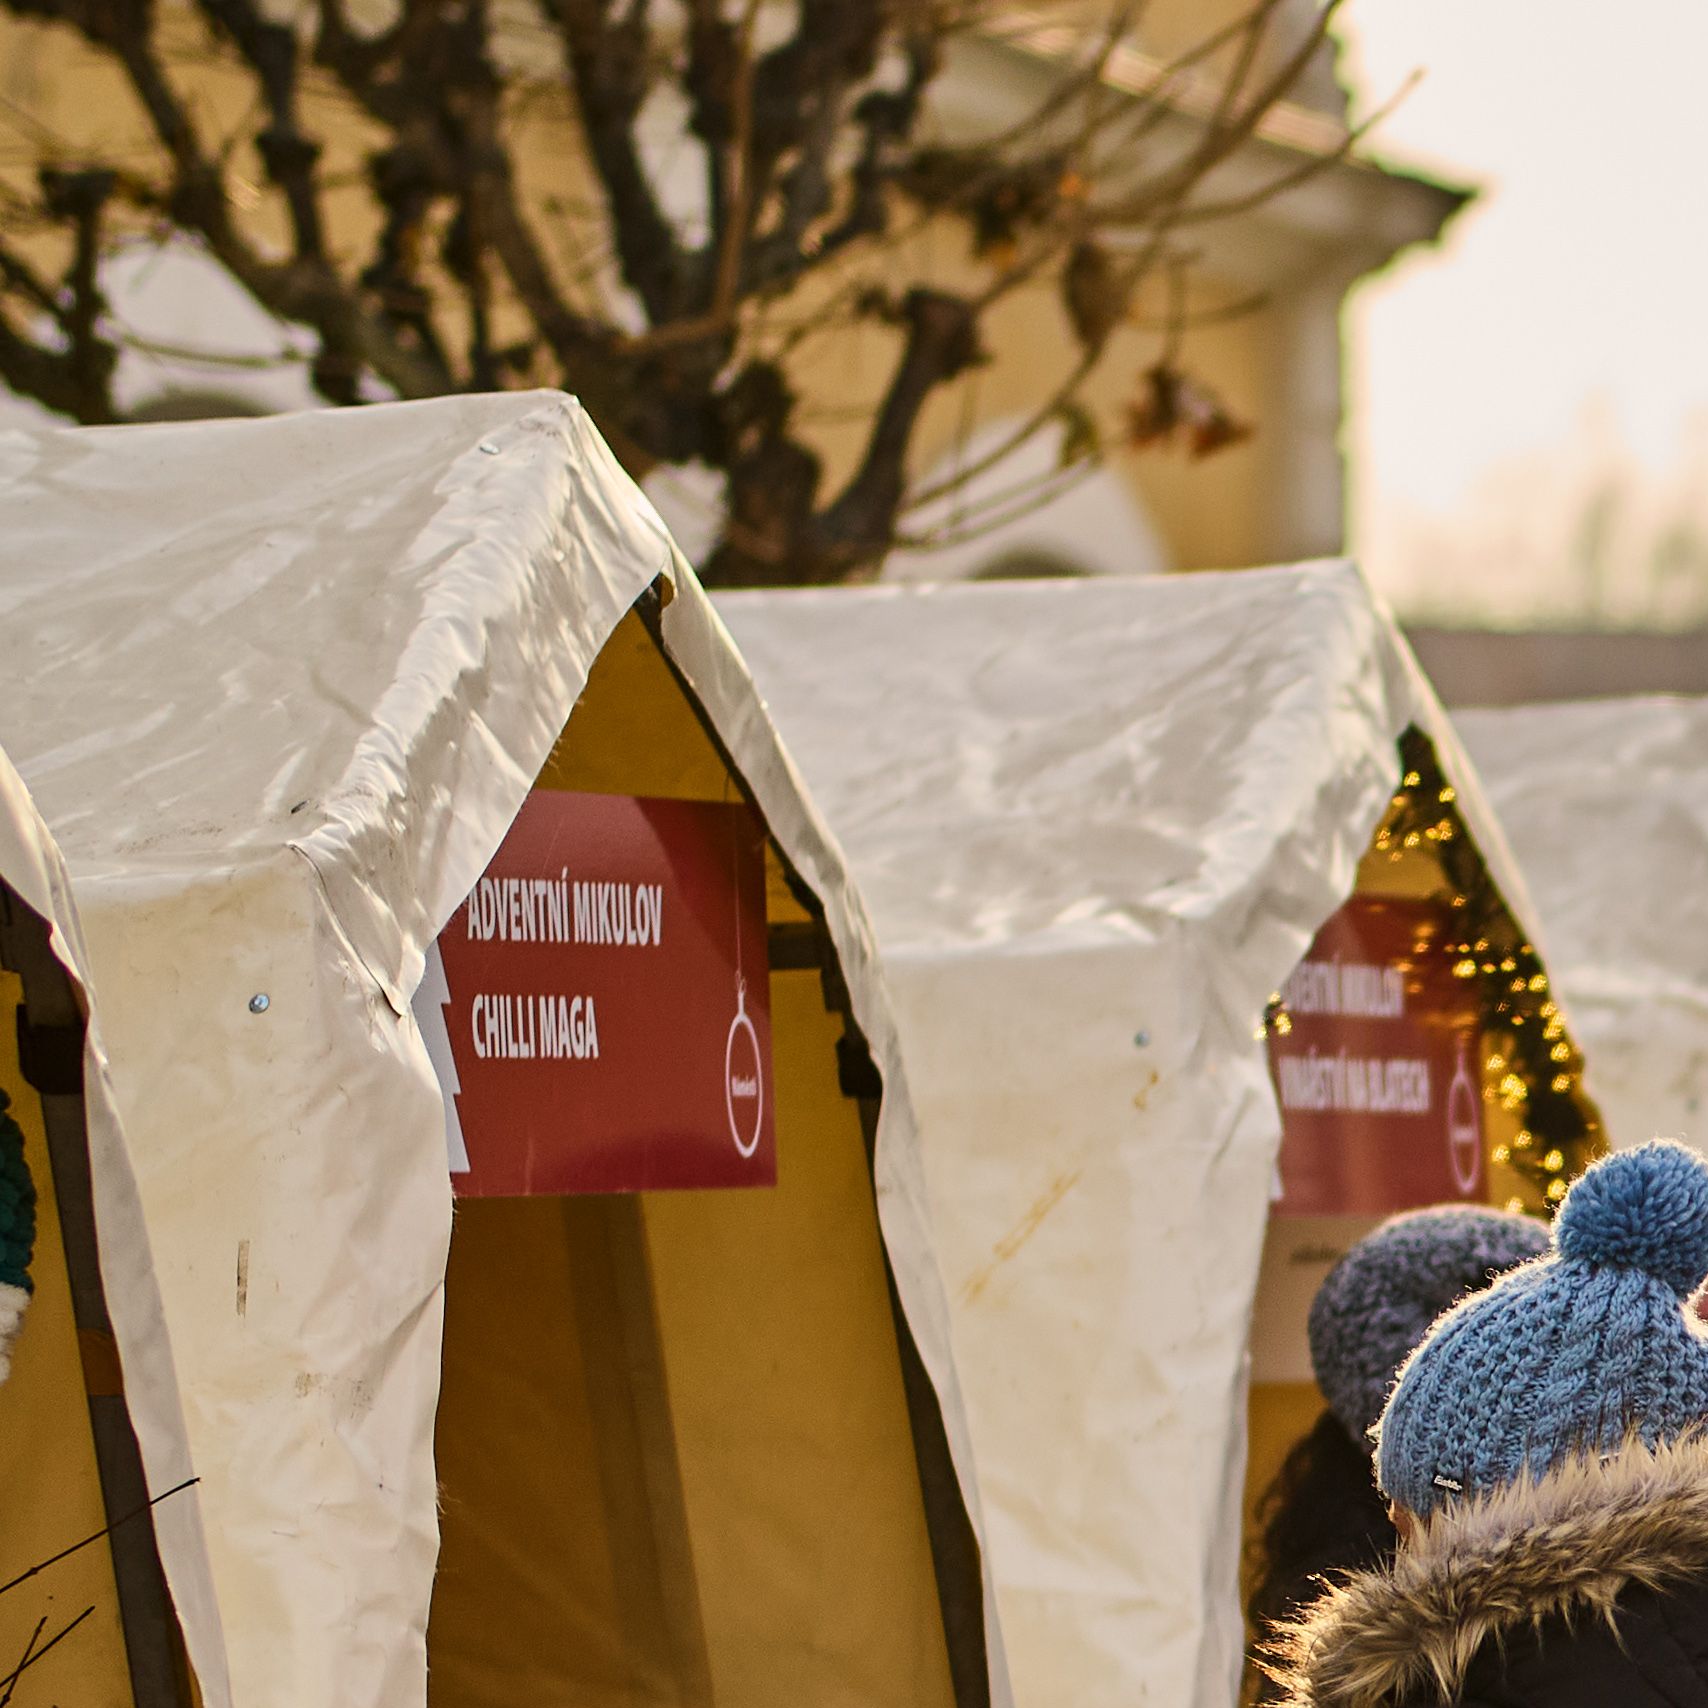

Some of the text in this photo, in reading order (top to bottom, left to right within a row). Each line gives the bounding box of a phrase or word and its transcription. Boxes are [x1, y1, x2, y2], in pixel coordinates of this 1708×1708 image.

[467, 866, 662, 947] ADVENTNÍ MIKULOV
[472, 993, 600, 1060] CHILLI MAGA
